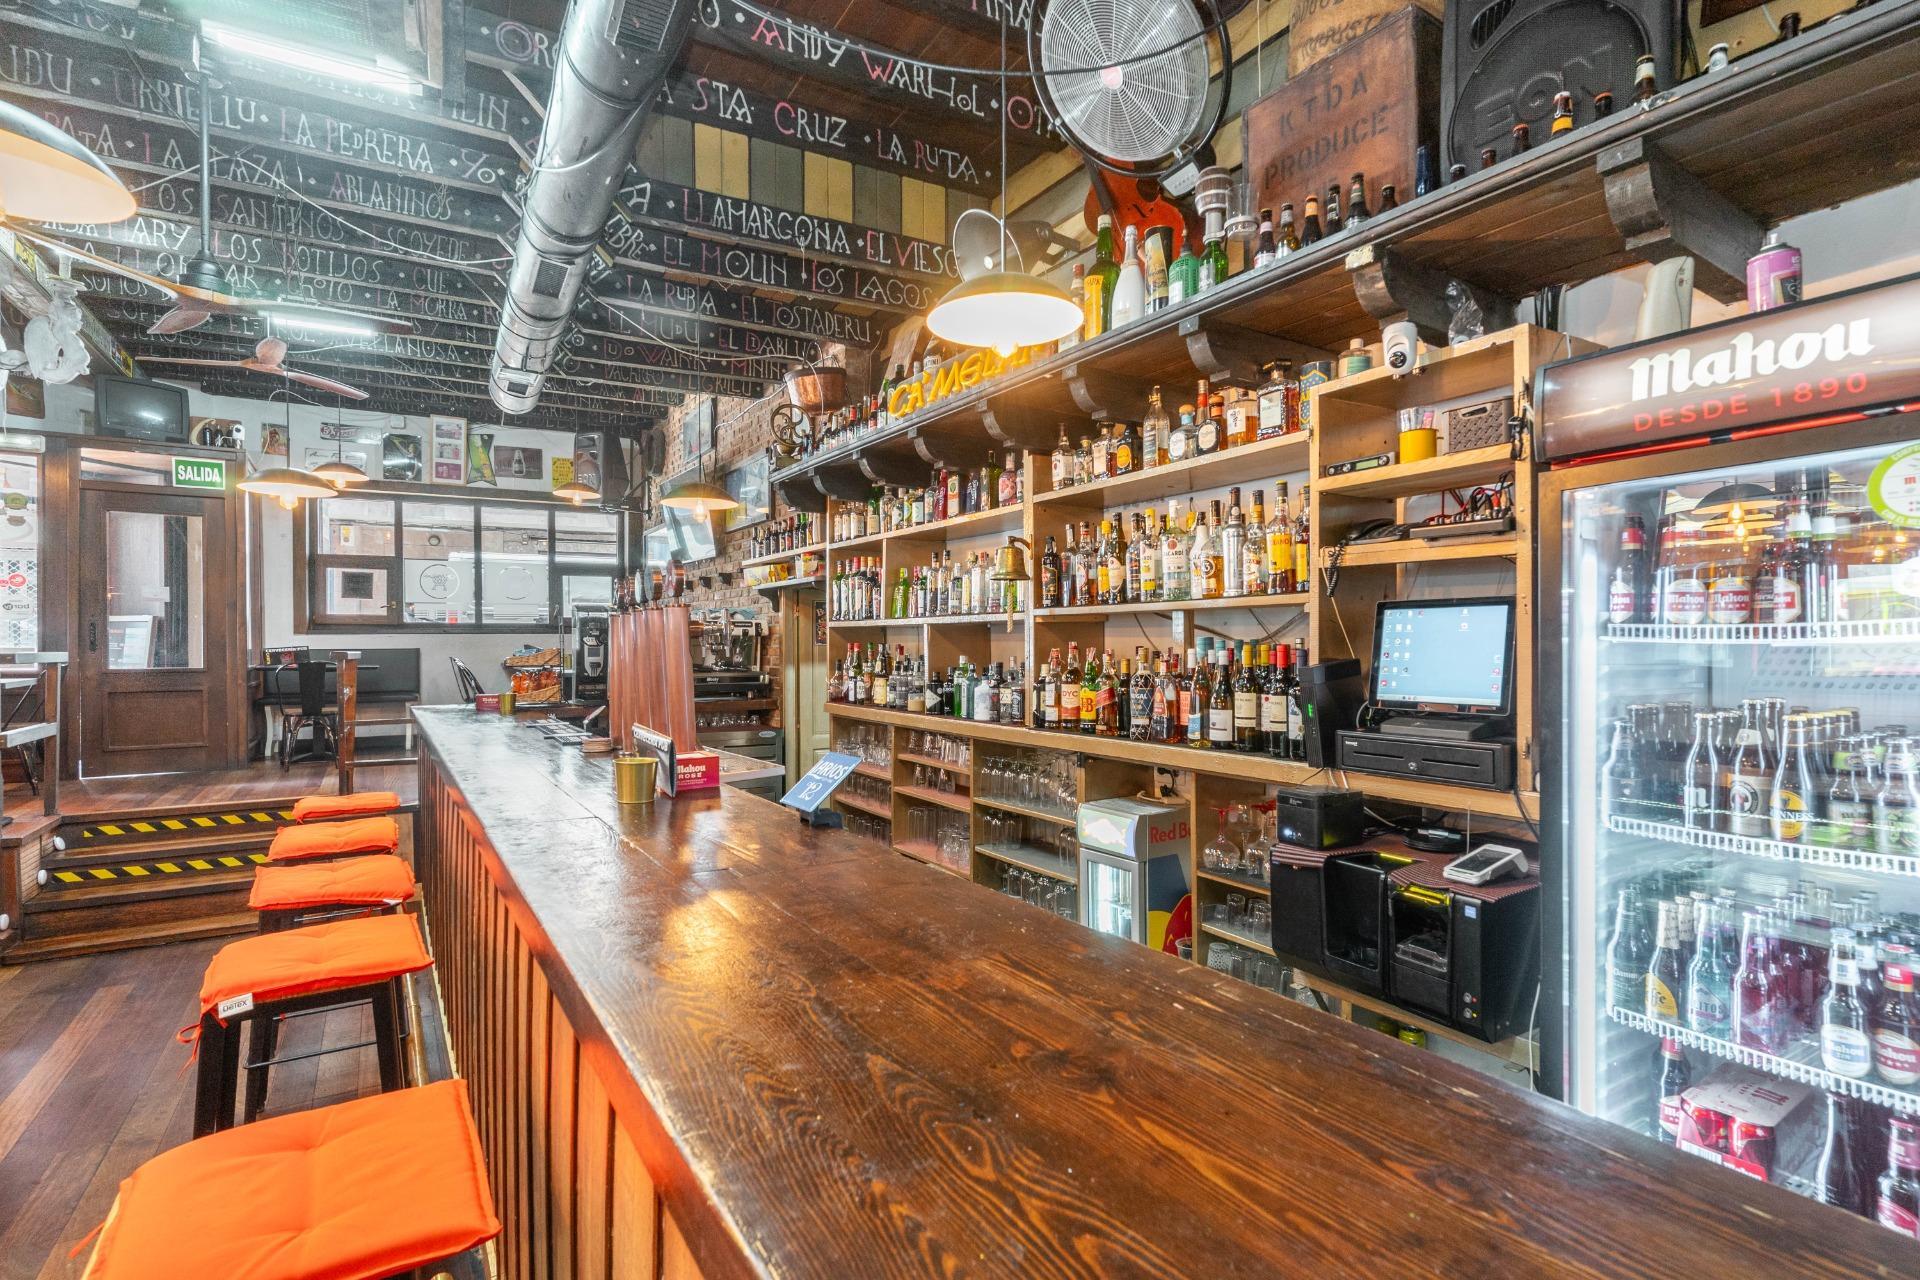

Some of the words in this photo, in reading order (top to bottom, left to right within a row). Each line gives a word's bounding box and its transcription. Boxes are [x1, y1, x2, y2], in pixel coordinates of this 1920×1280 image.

[750, 14, 850, 68] ANDY
[279, 108, 317, 149] LA
[325, 116, 434, 174] PEDRERA
[774, 100, 847, 148] CRUZ
[1263, 105, 1391, 190] PRODUCE
[876, 128, 908, 166] LA
[914, 138, 980, 185] RUTA
[141, 178, 195, 215] LOS
[212, 229, 263, 264] LOS
[662, 233, 692, 268] EL
[701, 241, 789, 288] MOLIN
[865, 229, 892, 265] EL
[412, 265, 449, 295] CUE
[625, 273, 655, 306] LA
[810, 258, 846, 296] LOS
[853, 270, 934, 311] LAGOS
[717, 327, 739, 351] EL
[741, 295, 765, 324] EL
[770, 301, 871, 344] TOSTADERU
[1627, 317, 1877, 402] Mahou
[1632, 391, 1748, 432] DESDE
[1771, 371, 1868, 407] 1890
[177, 463, 222, 483] SALIDA
[808, 759, 850, 783] LARIOS
[1149, 822, 1177, 845] Red
